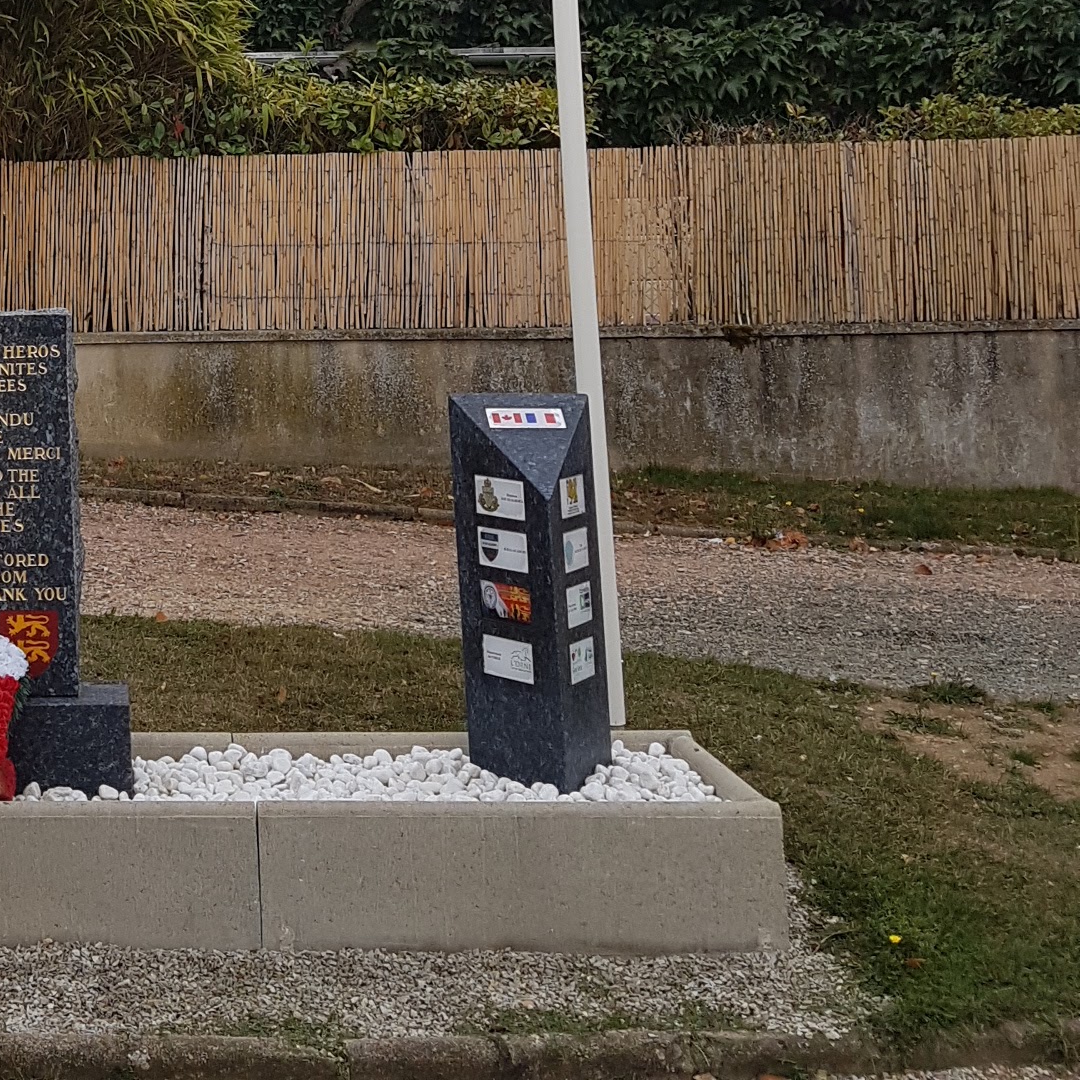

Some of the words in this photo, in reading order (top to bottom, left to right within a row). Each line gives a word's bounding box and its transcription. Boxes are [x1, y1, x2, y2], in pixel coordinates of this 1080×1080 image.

[3, 344, 61, 360] HEROS
[7, 446, 61, 460] MERCI
[7, 469, 40, 482] THE
[7, 486, 41, 499] ALL
[34, 587, 68, 601] YOU
